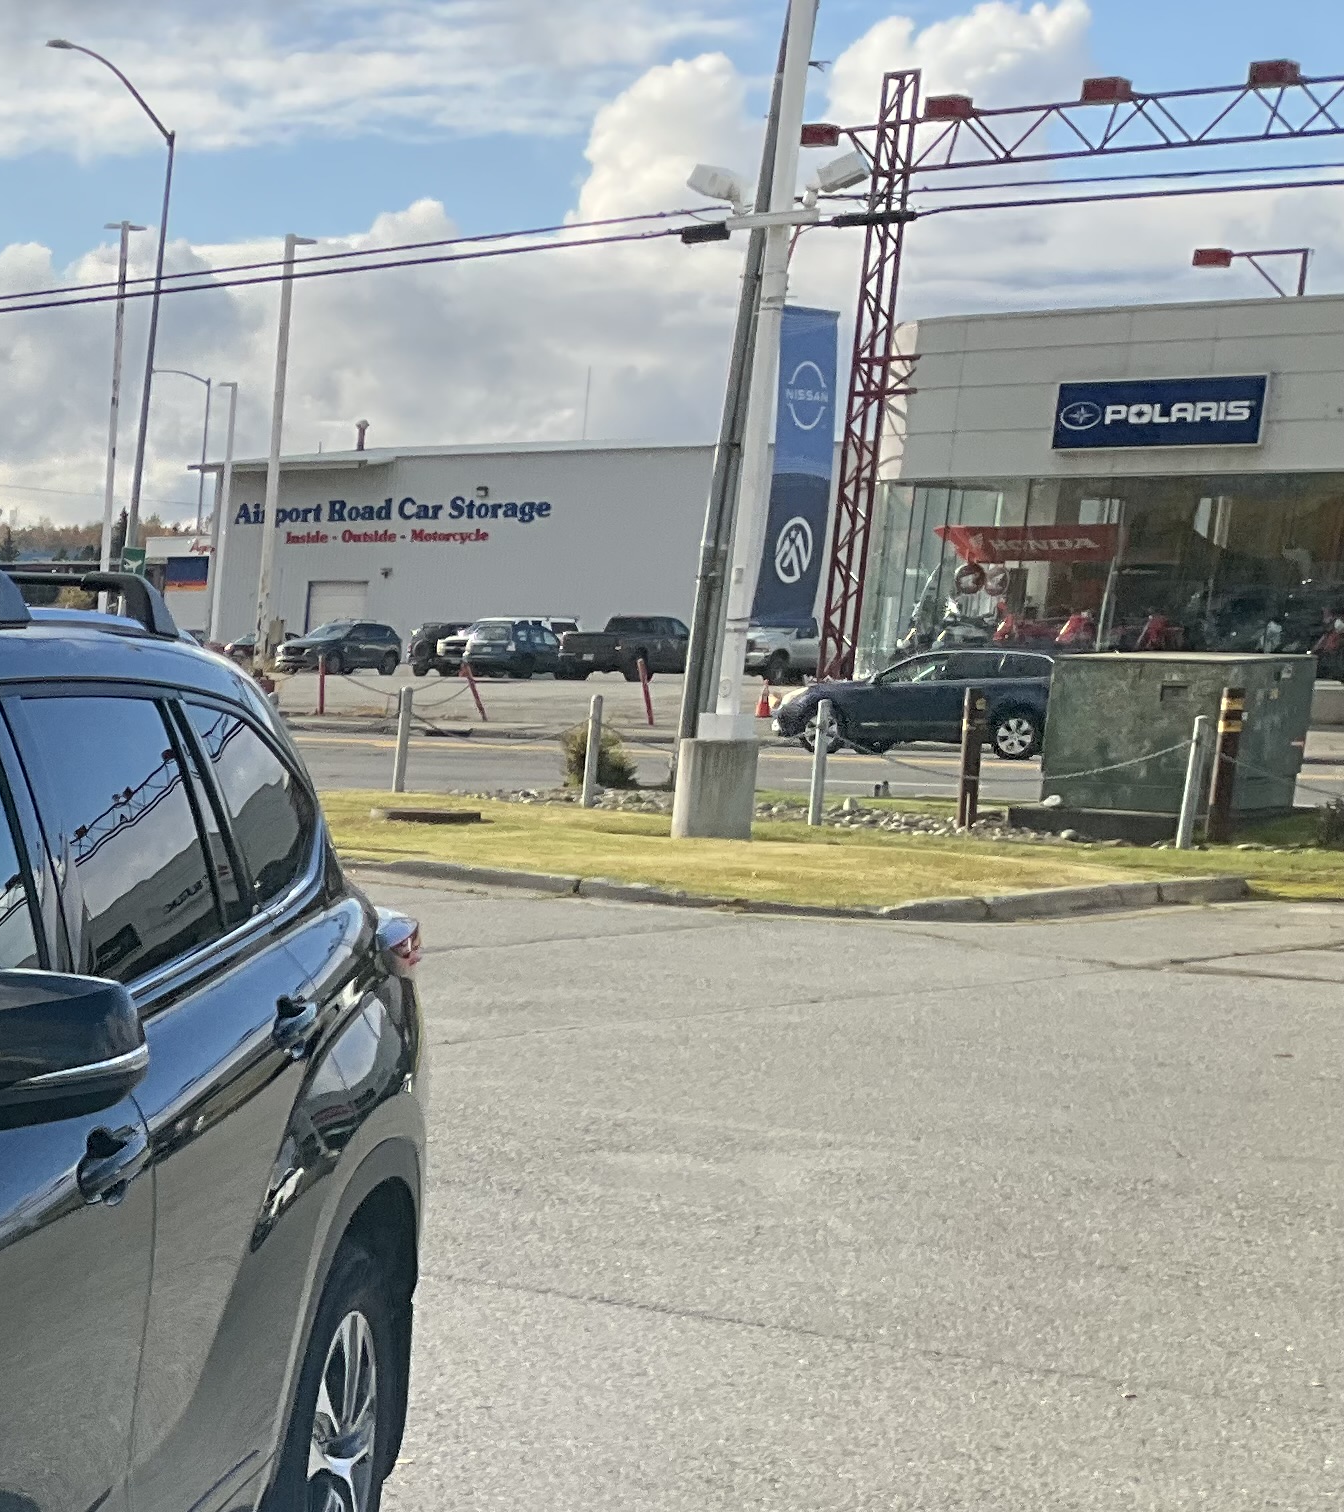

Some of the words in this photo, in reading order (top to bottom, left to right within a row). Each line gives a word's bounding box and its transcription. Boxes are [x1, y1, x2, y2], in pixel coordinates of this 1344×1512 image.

[786, 387, 829, 402] NISSAN
[1103, 401, 1251, 425] POLARIS
[327, 499, 392, 523] Road
[398, 497, 444, 520] Car
[448, 495, 553, 524] Storage
[285, 530, 328, 545] Inside
[341, 529, 397, 544] Outside
[411, 529, 490, 545] Motorcycle
[989, 537, 1100, 553] HONDA
